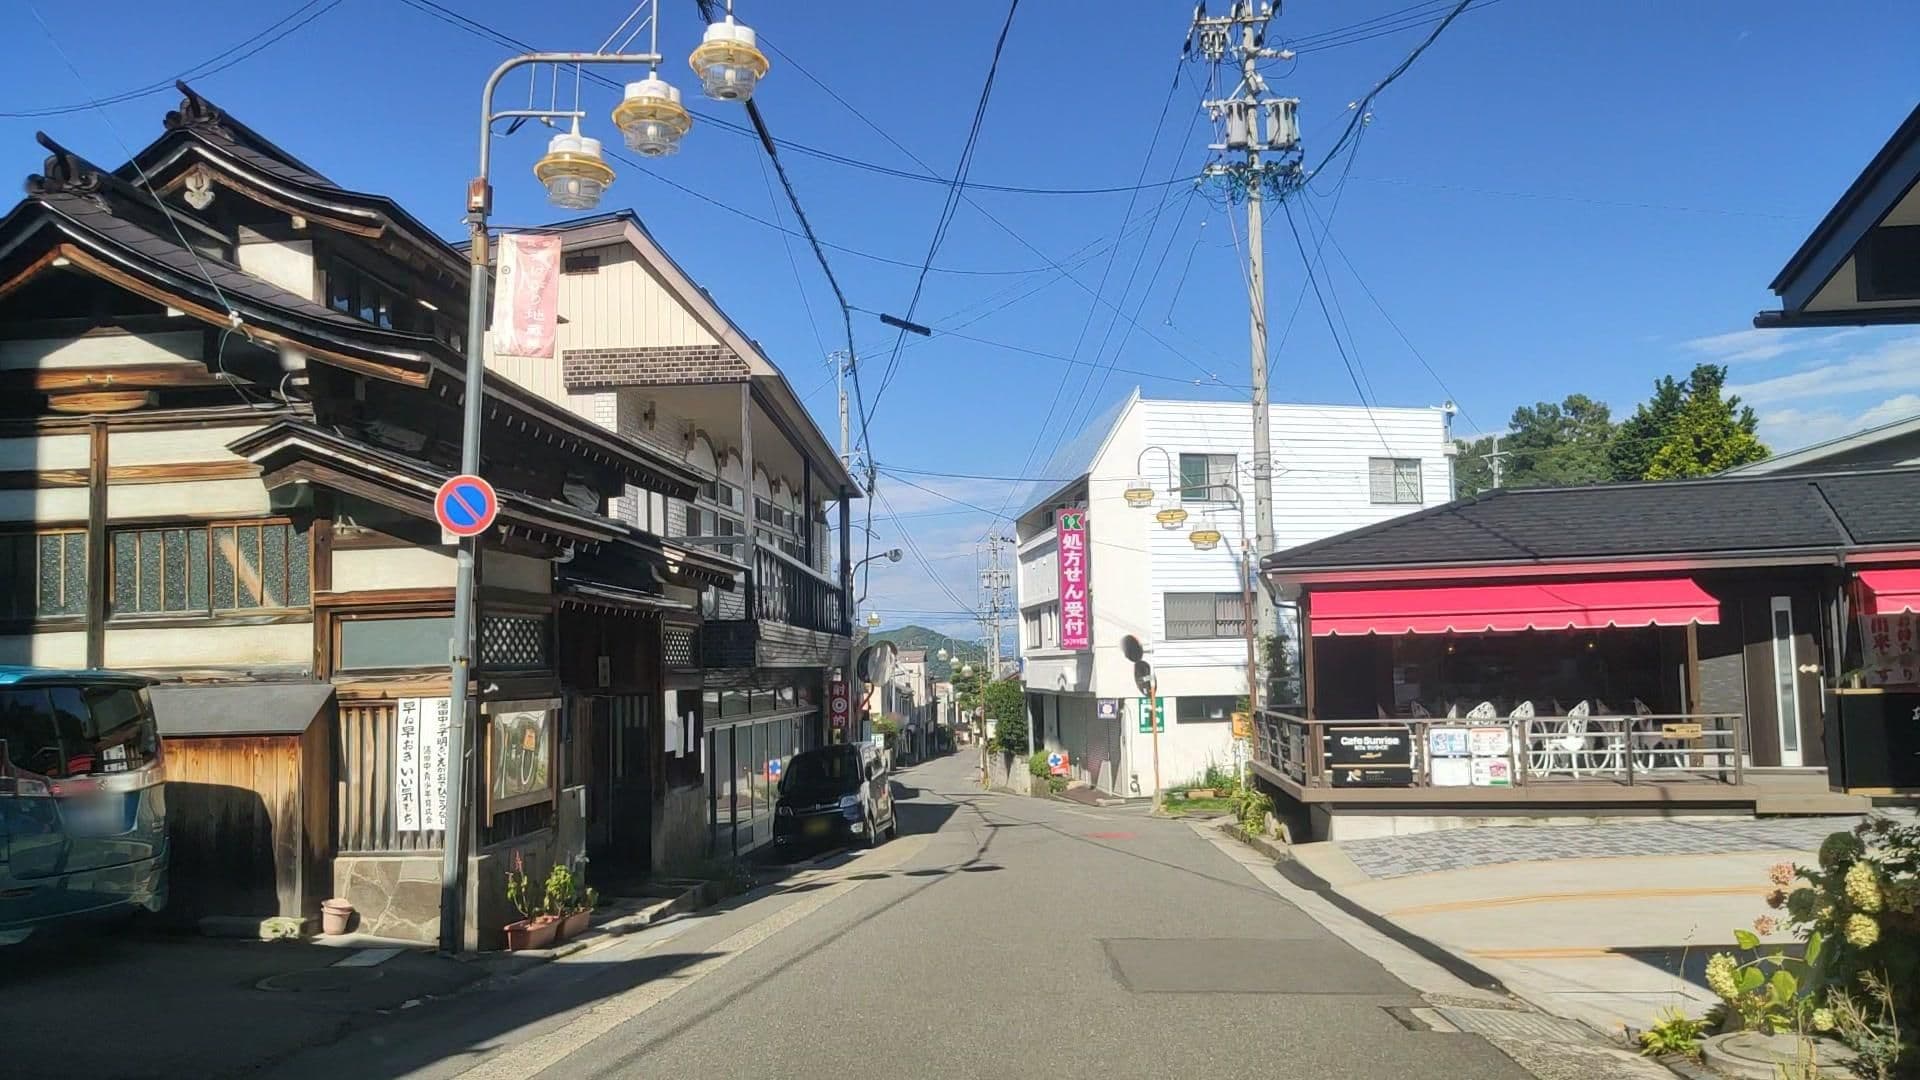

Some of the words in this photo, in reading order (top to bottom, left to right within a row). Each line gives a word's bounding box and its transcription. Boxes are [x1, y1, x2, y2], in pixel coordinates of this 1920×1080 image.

[1062, 533, 1085, 636] 処方せん受付
[1340, 736, 1363, 745] Cafe
[1363, 736, 1400, 745] Sunrise
